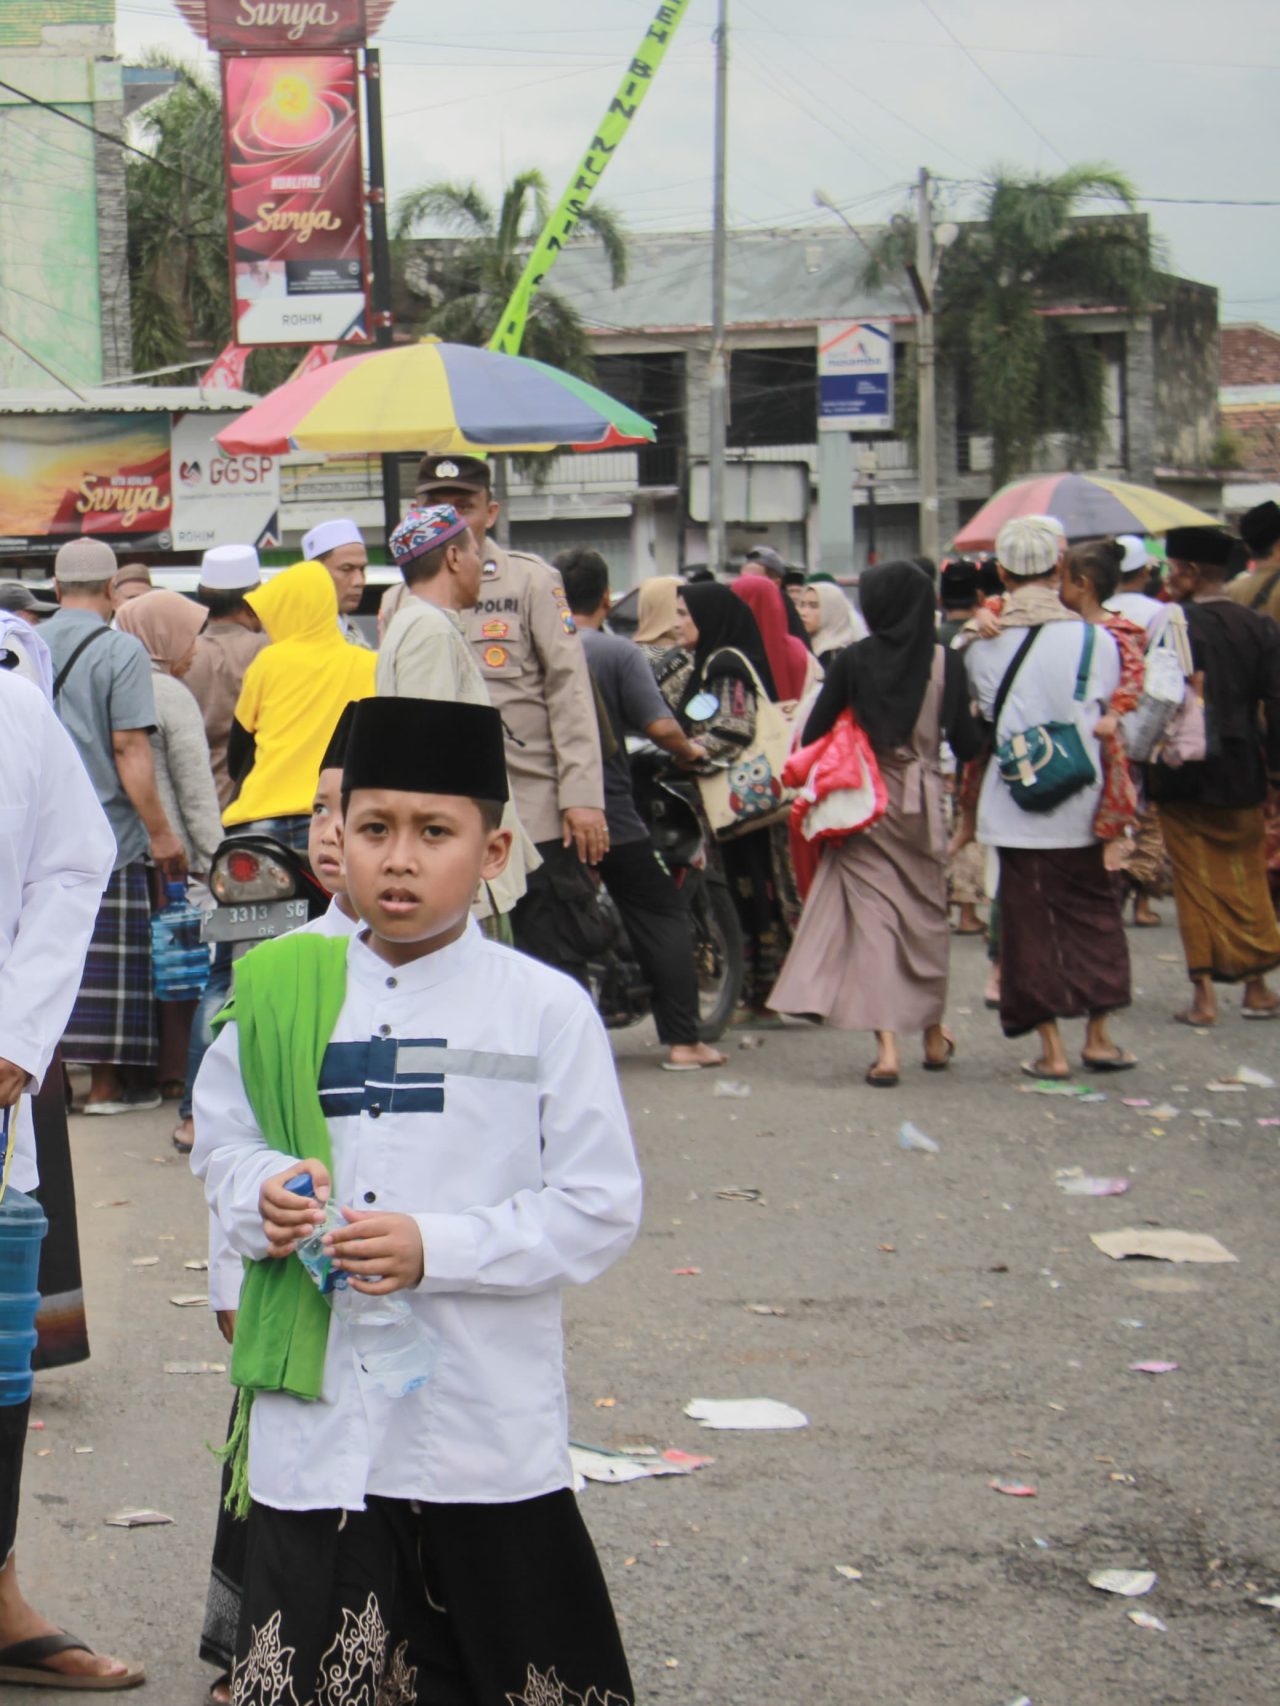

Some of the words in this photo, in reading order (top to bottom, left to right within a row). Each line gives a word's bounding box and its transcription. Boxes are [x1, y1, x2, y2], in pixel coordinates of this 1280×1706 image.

[237, 0, 339, 40] Surya
[608, 57, 654, 120] BIN
[256, 203, 341, 243] Surya
[282, 313, 322, 326] ROHIM
[209, 456, 273, 485] GGSP
[76, 475, 171, 527] Surya
[178, 530, 215, 542] ROHIM
[474, 598, 519, 614] POLRI
[229, 905, 268, 923] 3313
